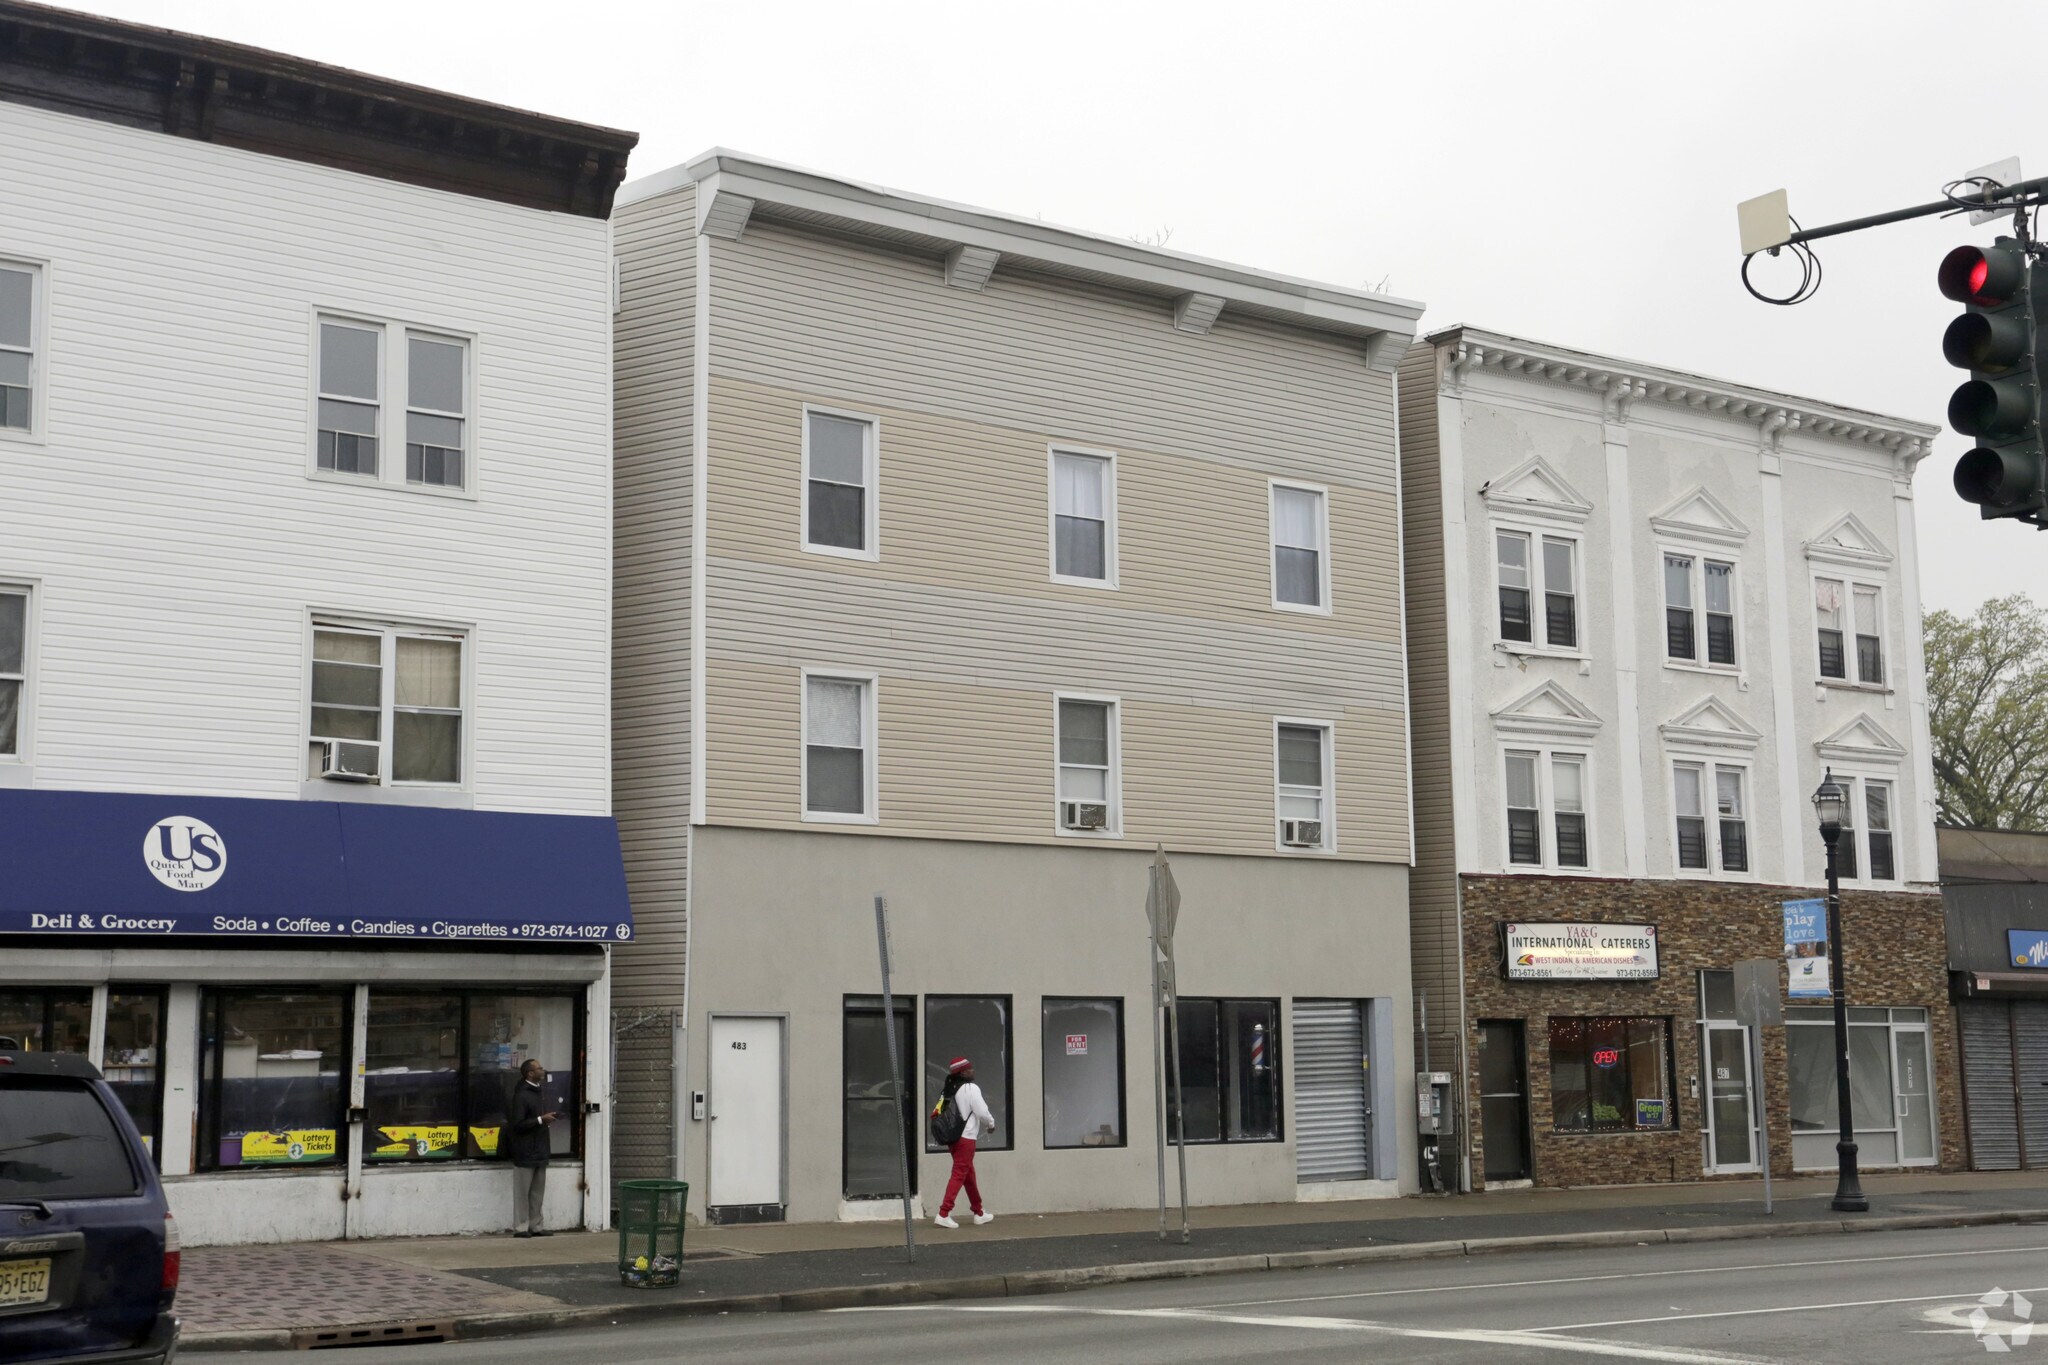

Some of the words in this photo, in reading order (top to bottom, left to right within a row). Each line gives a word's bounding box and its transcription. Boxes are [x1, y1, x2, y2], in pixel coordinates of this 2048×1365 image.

[155, 825, 221, 872] US
[151, 859, 185, 870] Quick
[167, 870, 194, 879] Food
[178, 880, 204, 888] Mart
[1784, 903, 1804, 914] eat
[31, 914, 73, 929] Deli
[78, 915, 96, 929] &
[101, 914, 177, 932] Grocery
[1785, 914, 1816, 927] play
[213, 916, 257, 931] Soda
[276, 917, 331, 932] Coffee
[351, 919, 415, 935] Candies
[432, 921, 508, 938] Cigarettes
[521, 924, 608, 938] 973-674-1027
[1786, 928, 1816, 939] love
[1512, 937, 1594, 949] INTERNATIONAL
[1601, 938, 1650, 949] CATERERS
[2029, 940, 2048, 965] Mi
[1582, 957, 1613, 965] AMERICAN
[1613, 957, 1634, 965] DISHES
[731, 1041, 746, 1050] 483
[1594, 1051, 1617, 1064] OPEN
[1639, 1102, 1663, 1113] Green
[302, 1134, 330, 1144] Lottery
[427, 1131, 453, 1141] Lottery
[306, 1142, 332, 1151] Tickets
